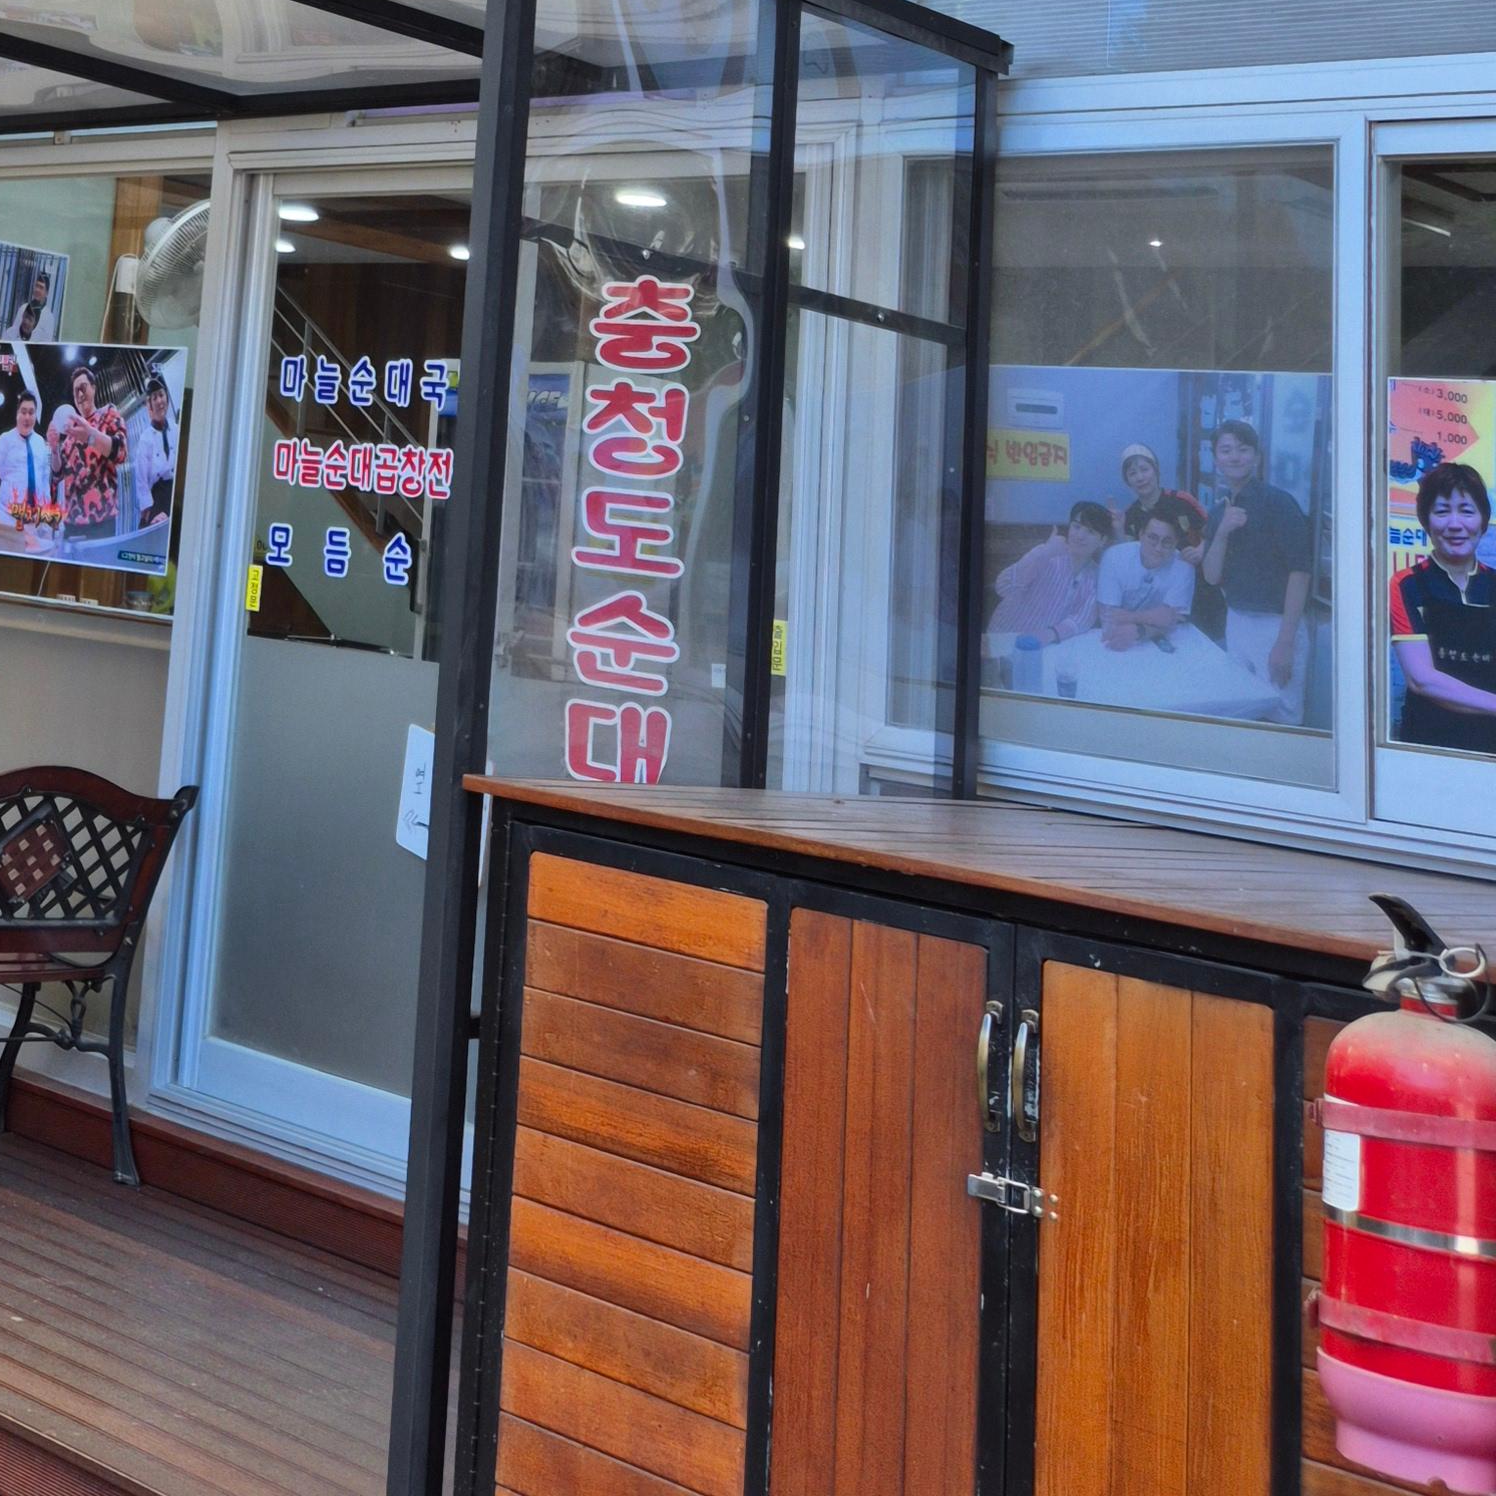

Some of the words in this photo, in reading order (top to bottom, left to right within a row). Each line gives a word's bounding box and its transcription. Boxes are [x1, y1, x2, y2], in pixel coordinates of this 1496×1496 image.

[274, 438, 454, 499] 마늘순대곱창전
[1006, 440, 1067, 466] 반입금지
[565, 275, 702, 784] 충청도순대
